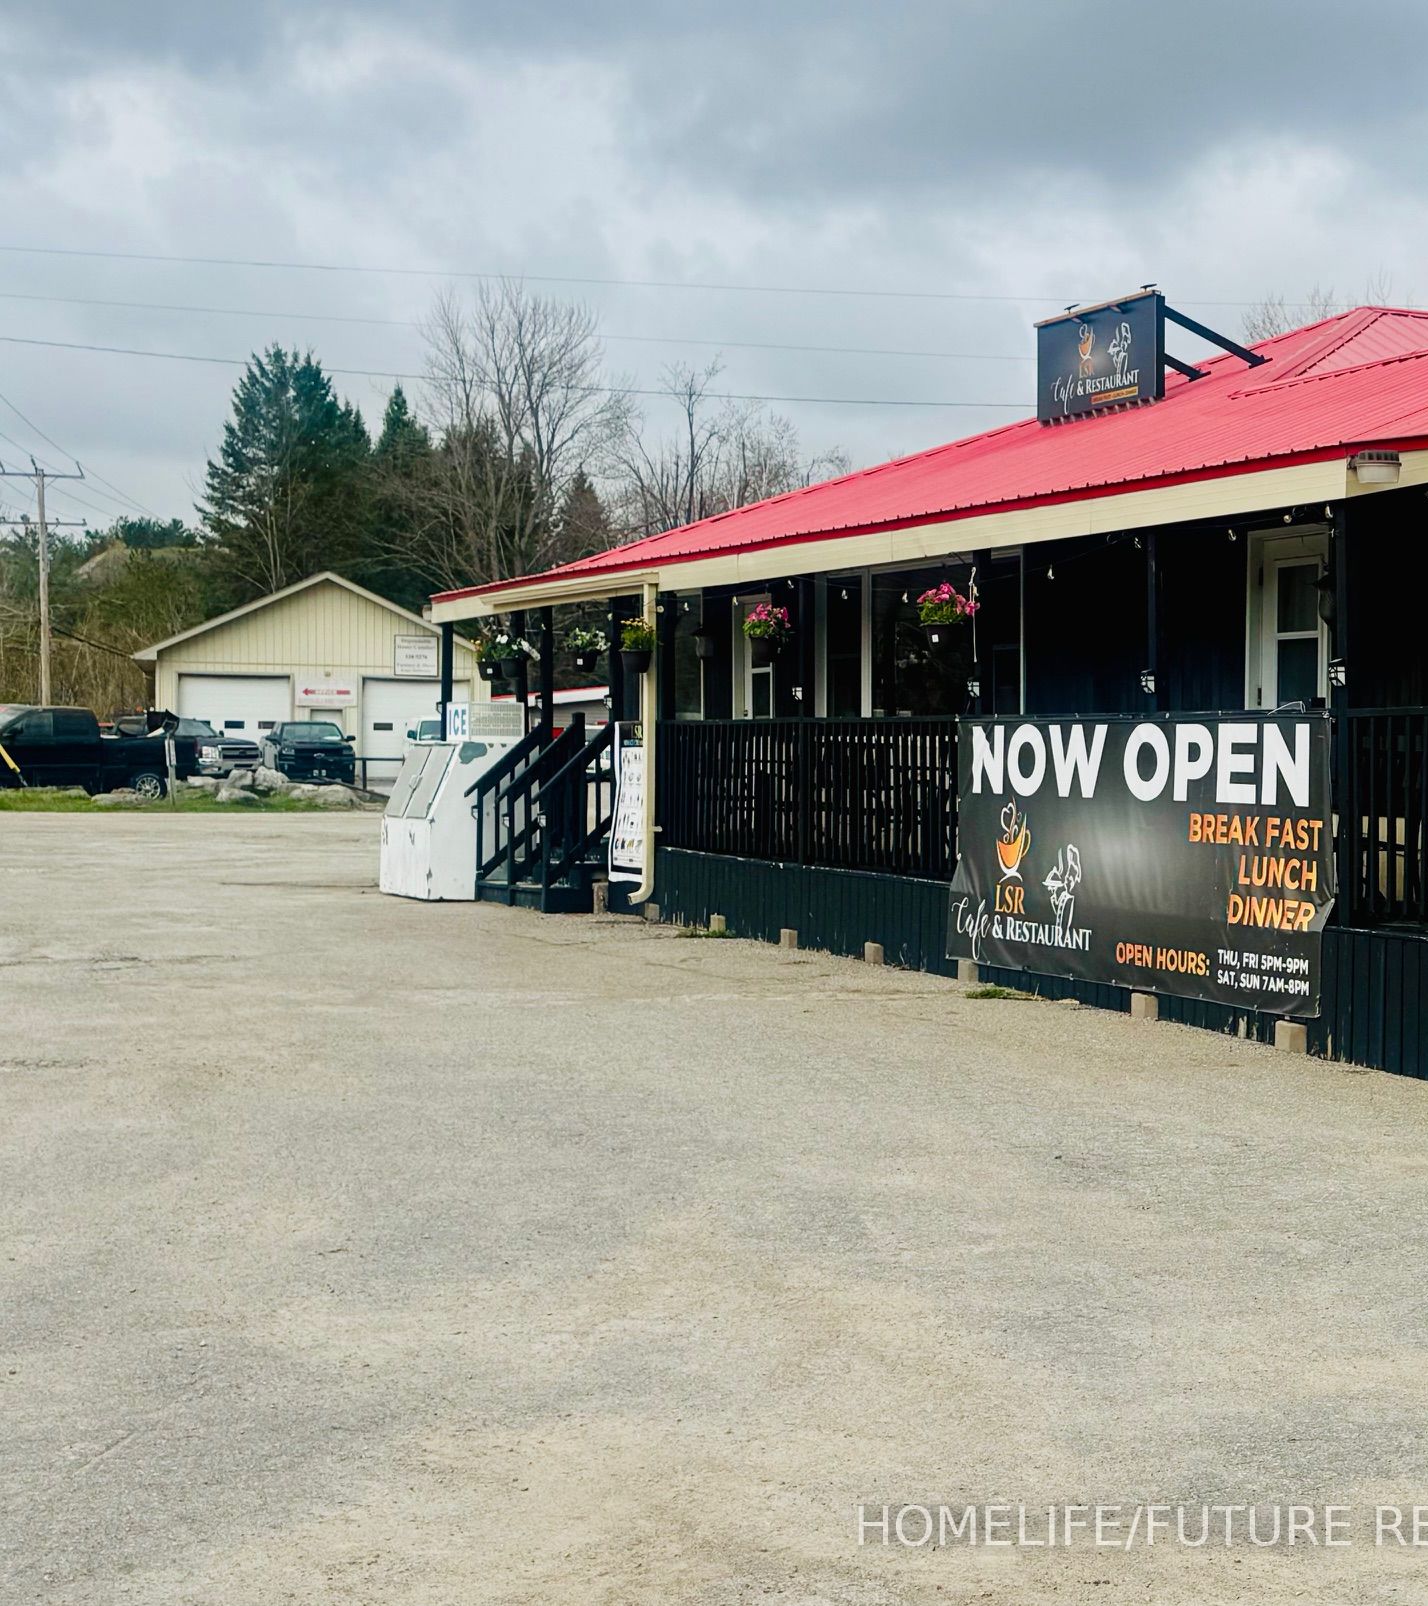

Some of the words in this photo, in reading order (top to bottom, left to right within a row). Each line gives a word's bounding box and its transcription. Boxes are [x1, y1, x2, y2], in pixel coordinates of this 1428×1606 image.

[1076, 381, 1085, 396] &
[1085, 369, 1140, 395] RESTAURANT
[449, 709, 467, 736] ICE
[972, 723, 1108, 798] NOW
[1123, 723, 1310, 808] OPEN
[1189, 813, 1260, 846] BREAK
[1265, 817, 1323, 851] FAST
[1238, 854, 1317, 892] LUNCH
[994, 884, 1025, 915] LSR
[1227, 894, 1316, 932] DINNER
[951, 896, 991, 960] Cafe
[992, 914, 1003, 939] &
[1005, 916, 1092, 951] RESTAURANT
[1116, 942, 1153, 968] OPEN
[1156, 947, 1210, 977] HOURS:
[1217, 949, 1240, 969] THU,
[1242, 953, 1259, 969] FRI
[1260, 955, 1309, 975] 5PM-9PM
[1217, 970, 1238, 990] SAT,
[1240, 973, 1260, 990] SUN
[1262, 976, 1310, 996] 7AM-8PM
